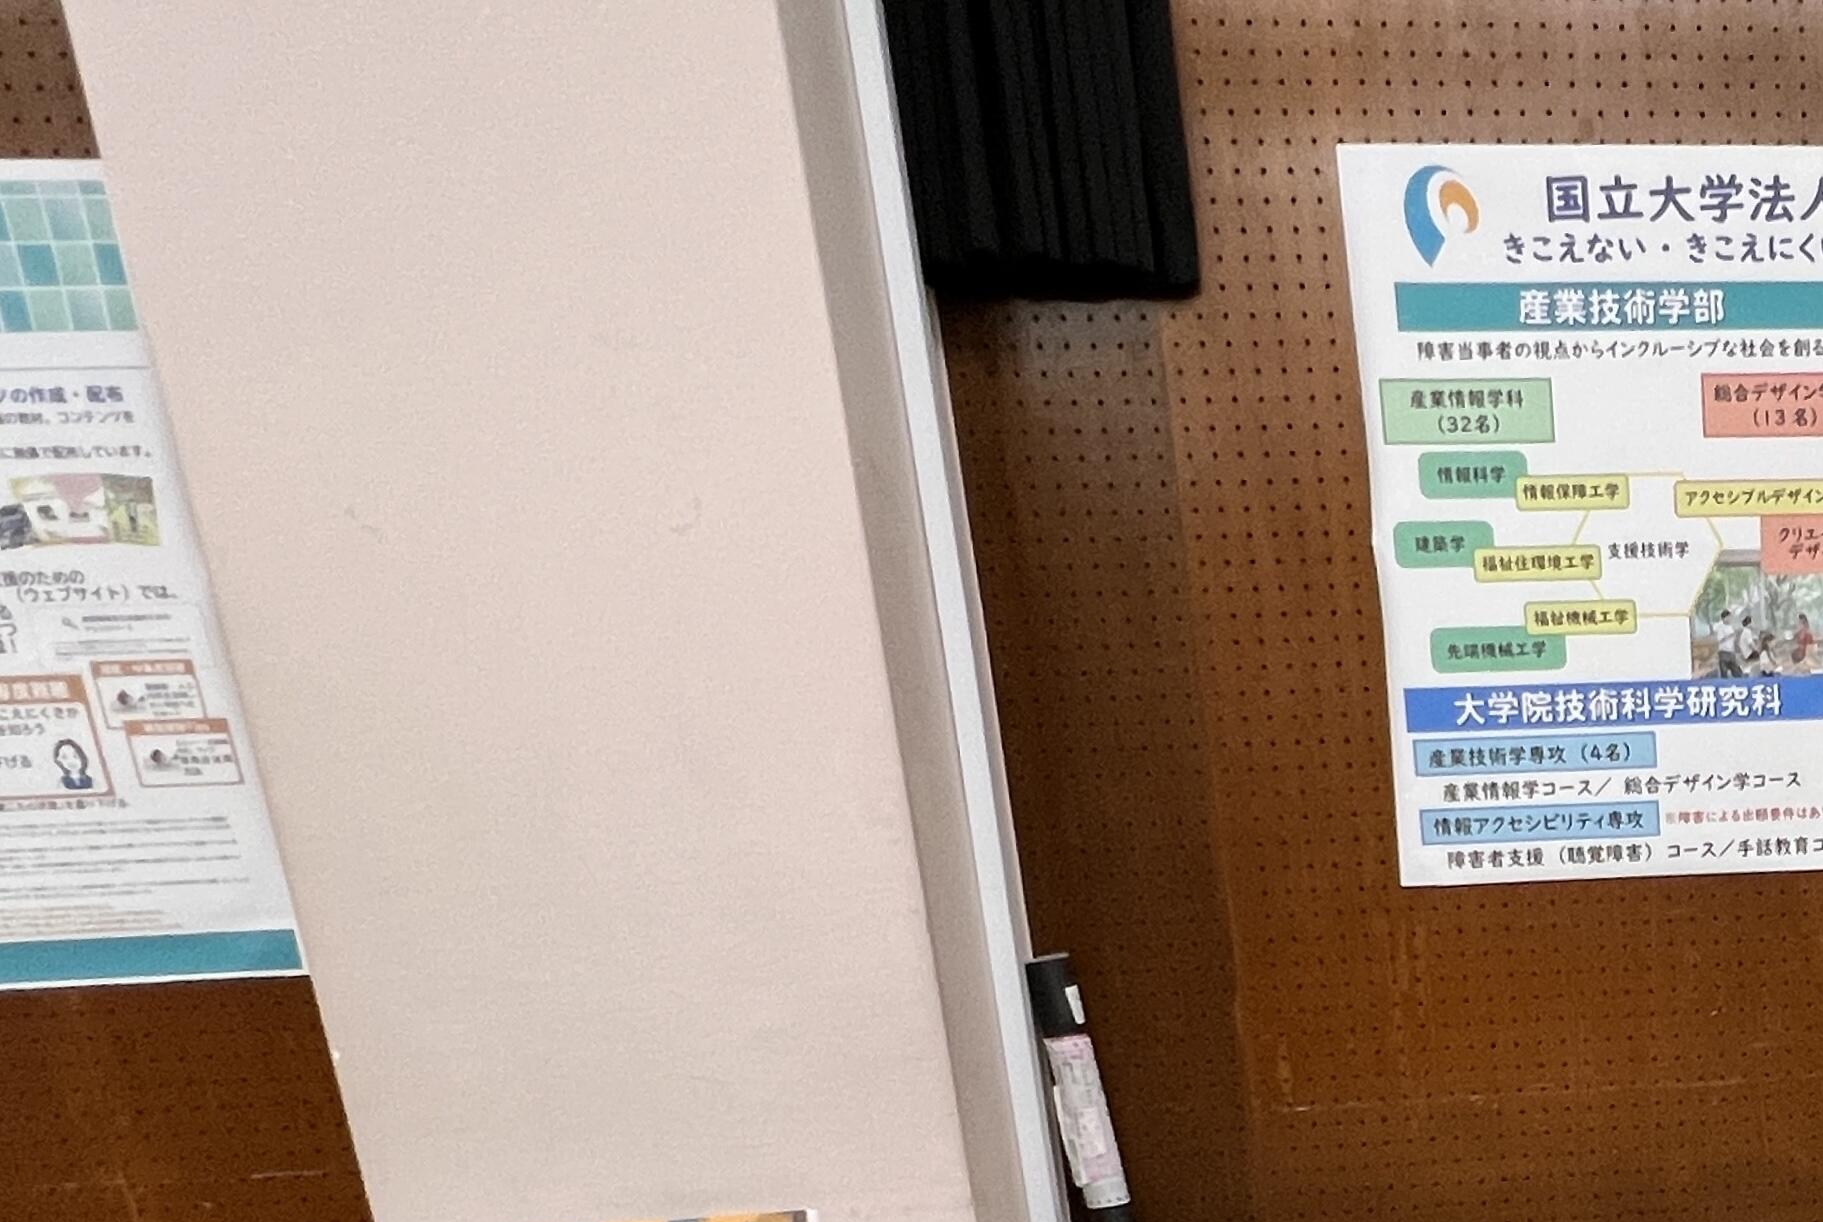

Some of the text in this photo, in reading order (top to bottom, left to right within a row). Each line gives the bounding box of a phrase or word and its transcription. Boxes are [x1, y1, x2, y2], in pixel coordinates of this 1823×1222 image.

[1519, 287, 1726, 326] 産業技術学部
[1410, 386, 1524, 410] 産業情報学科
[1437, 413, 1500, 435] (32名)
[1437, 465, 1506, 484] 情報科学
[1523, 482, 1620, 502] 情報保障工学
[1415, 535, 1465, 554] 建築学
[1608, 541, 1689, 561] 支援技術学
[1482, 552, 1594, 573] 福祉住環境工学
[1534, 607, 1629, 628] 福祉機械工学
[1447, 639, 1547, 660] 先端機械工学
[1454, 683, 1782, 727] 大学院技術科学研究科
[1434, 811, 1643, 838] 情報アクセシビリティ専攻
